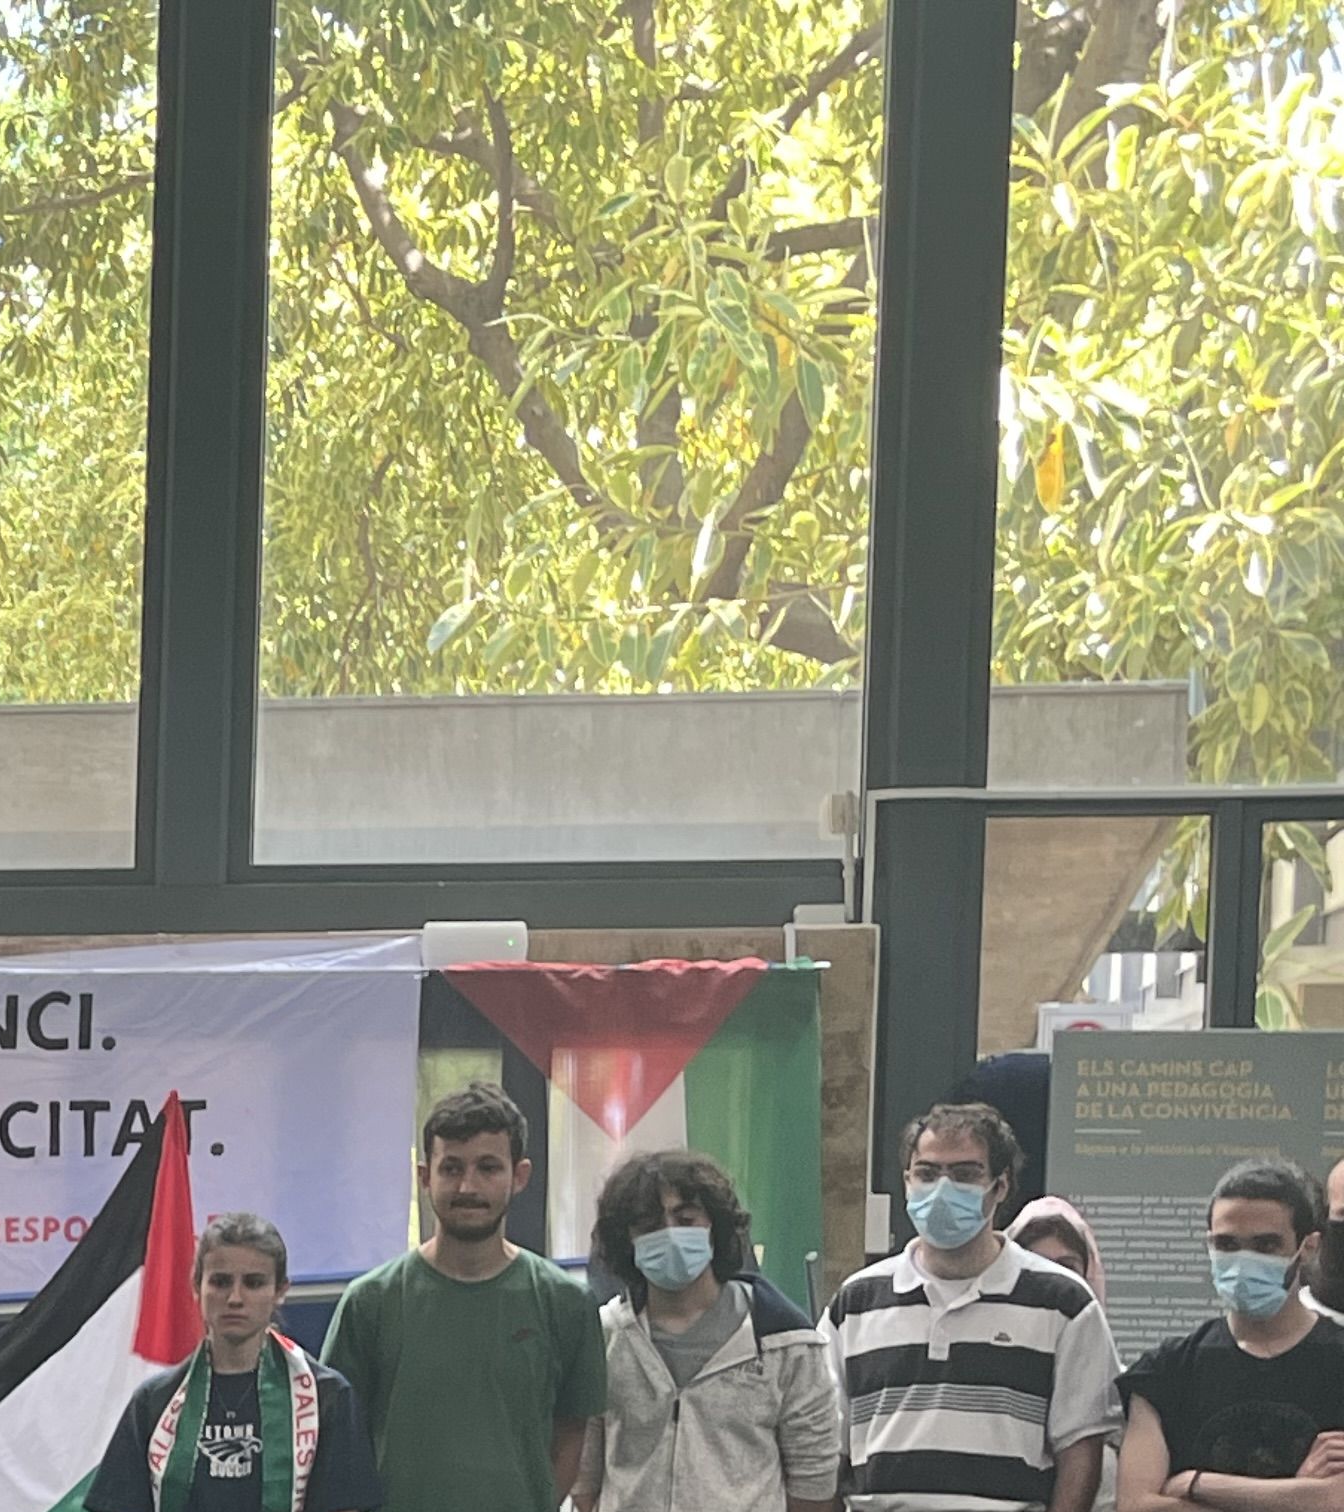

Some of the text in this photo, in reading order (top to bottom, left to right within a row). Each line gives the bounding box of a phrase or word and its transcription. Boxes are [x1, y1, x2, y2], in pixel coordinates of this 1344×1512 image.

[1077, 1060, 1254, 1077] ELS CAMINS CAP
[1076, 1081, 1274, 1099] A UNA PEDAGOGIA
[1075, 1102, 1103, 1119] DE
[1108, 1102, 1134, 1119] LA
